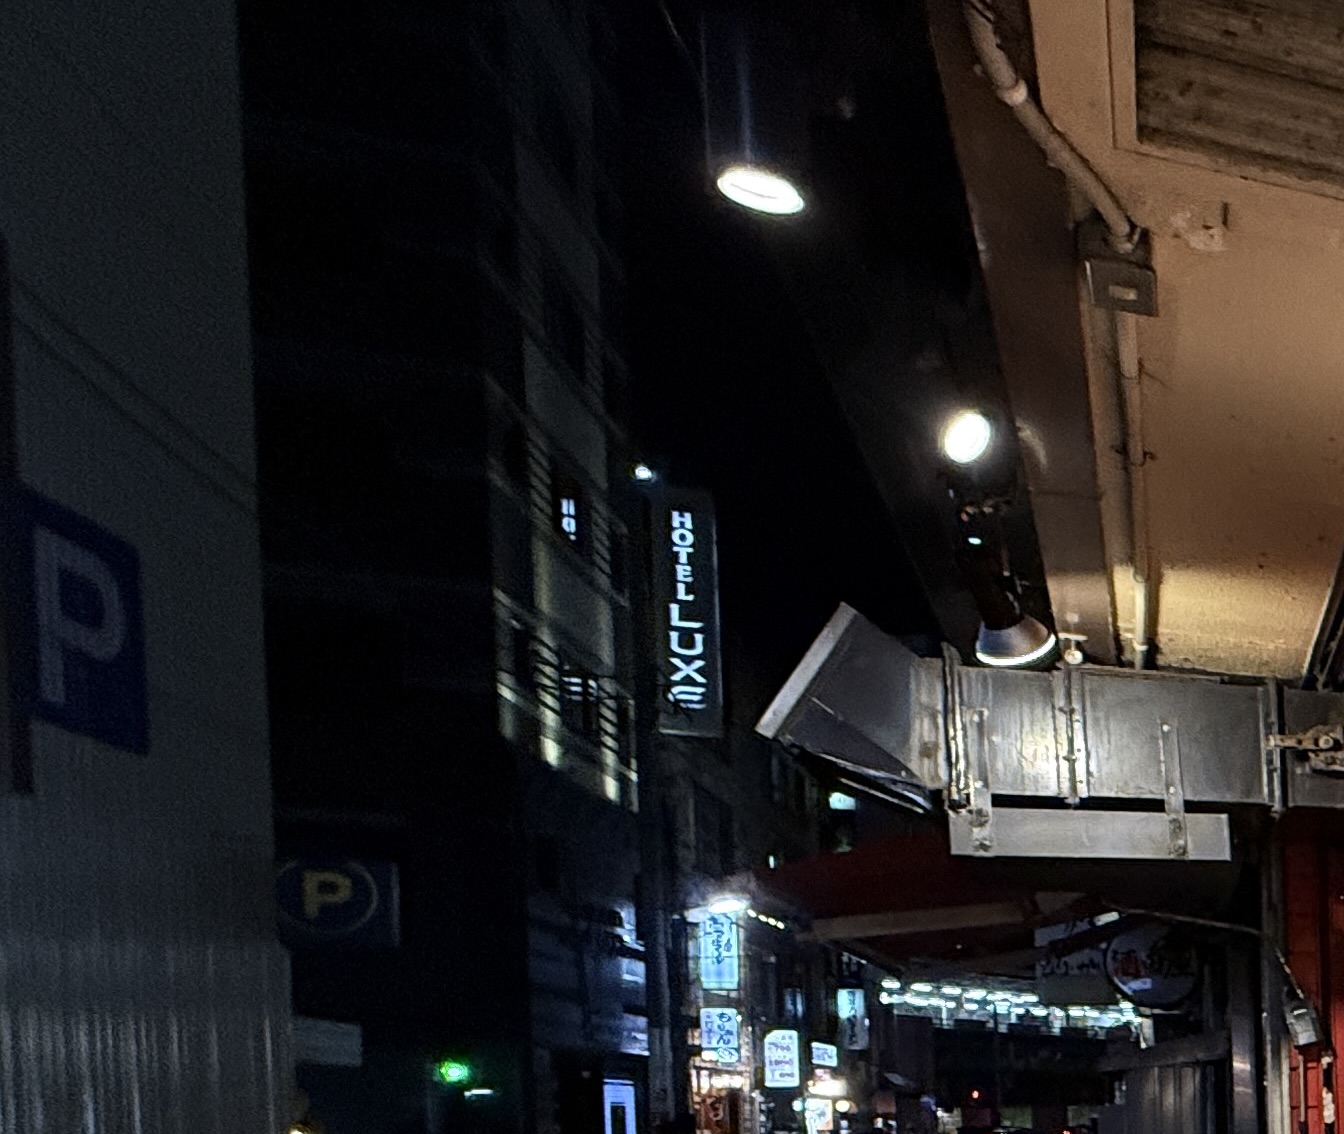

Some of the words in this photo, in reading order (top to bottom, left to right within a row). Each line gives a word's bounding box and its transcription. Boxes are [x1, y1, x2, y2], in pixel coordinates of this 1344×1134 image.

[670, 510, 694, 600] HOTEL
[35, 523, 126, 708] P
[302, 870, 352, 918] P
